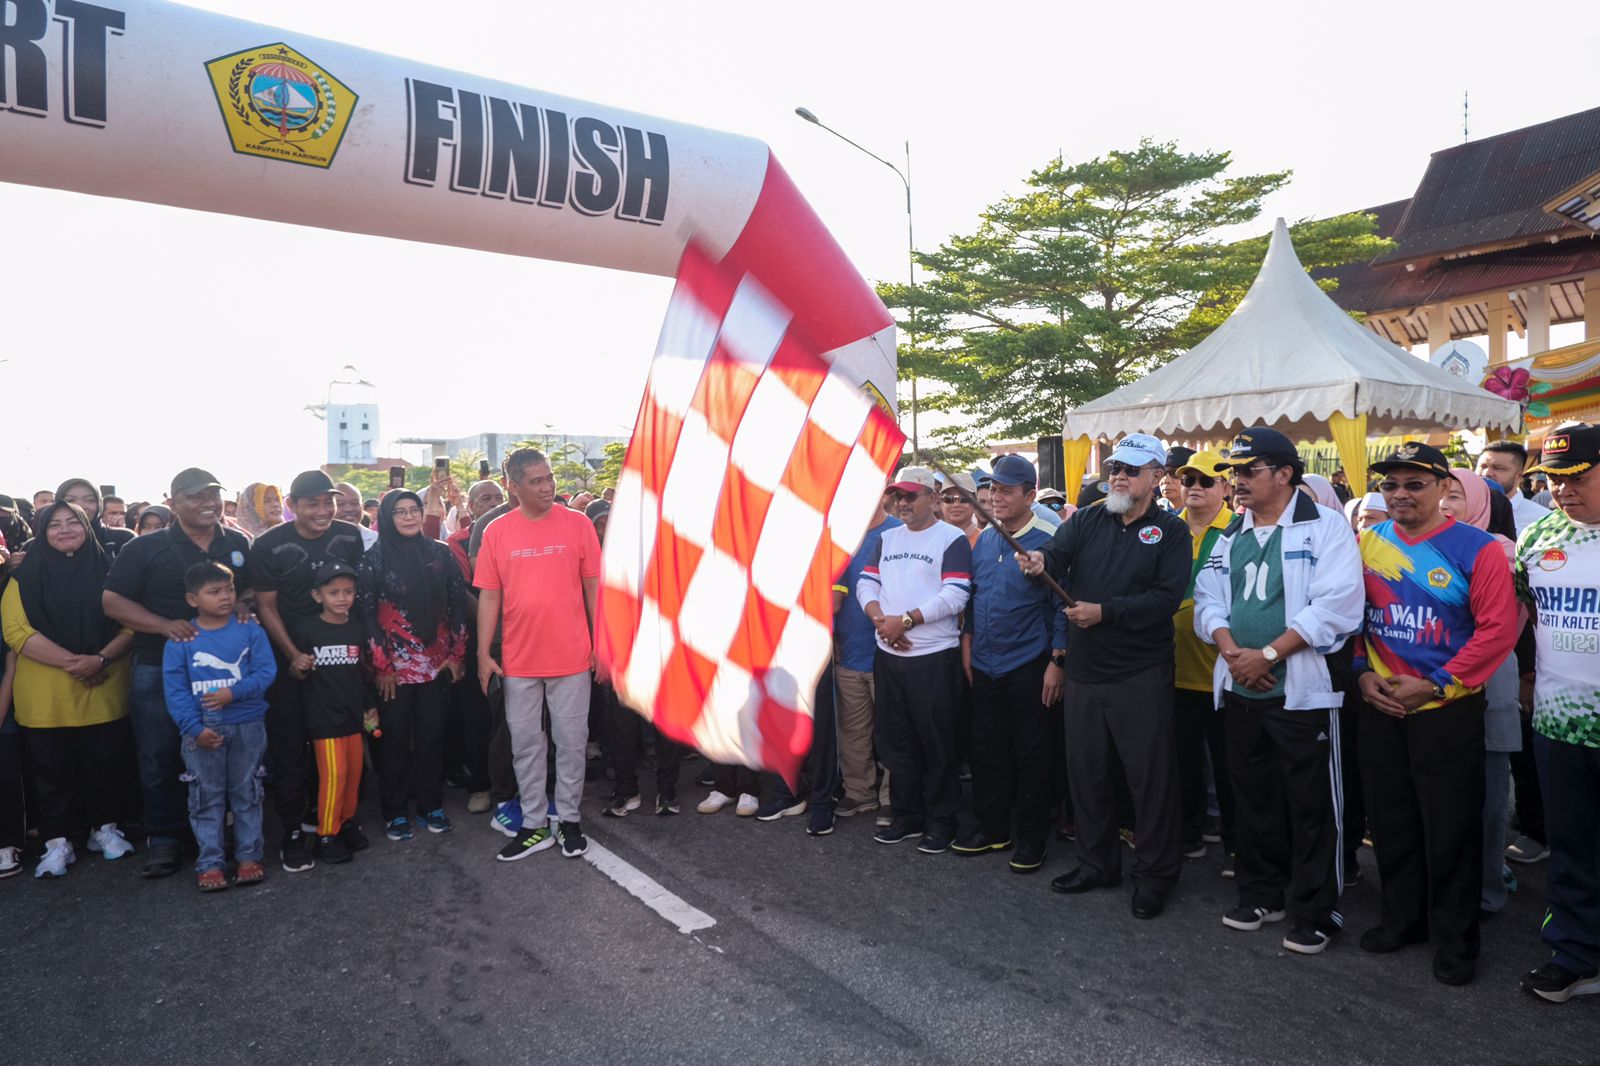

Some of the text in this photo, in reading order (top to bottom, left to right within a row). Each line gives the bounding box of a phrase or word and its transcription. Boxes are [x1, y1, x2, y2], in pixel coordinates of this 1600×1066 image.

[246, 143, 327, 162] KABUPATEN KARIMUN
[404, 77, 670, 226] FINISH
[313, 645, 347, 658] VANS
[1552, 630, 1600, 655] 2023
